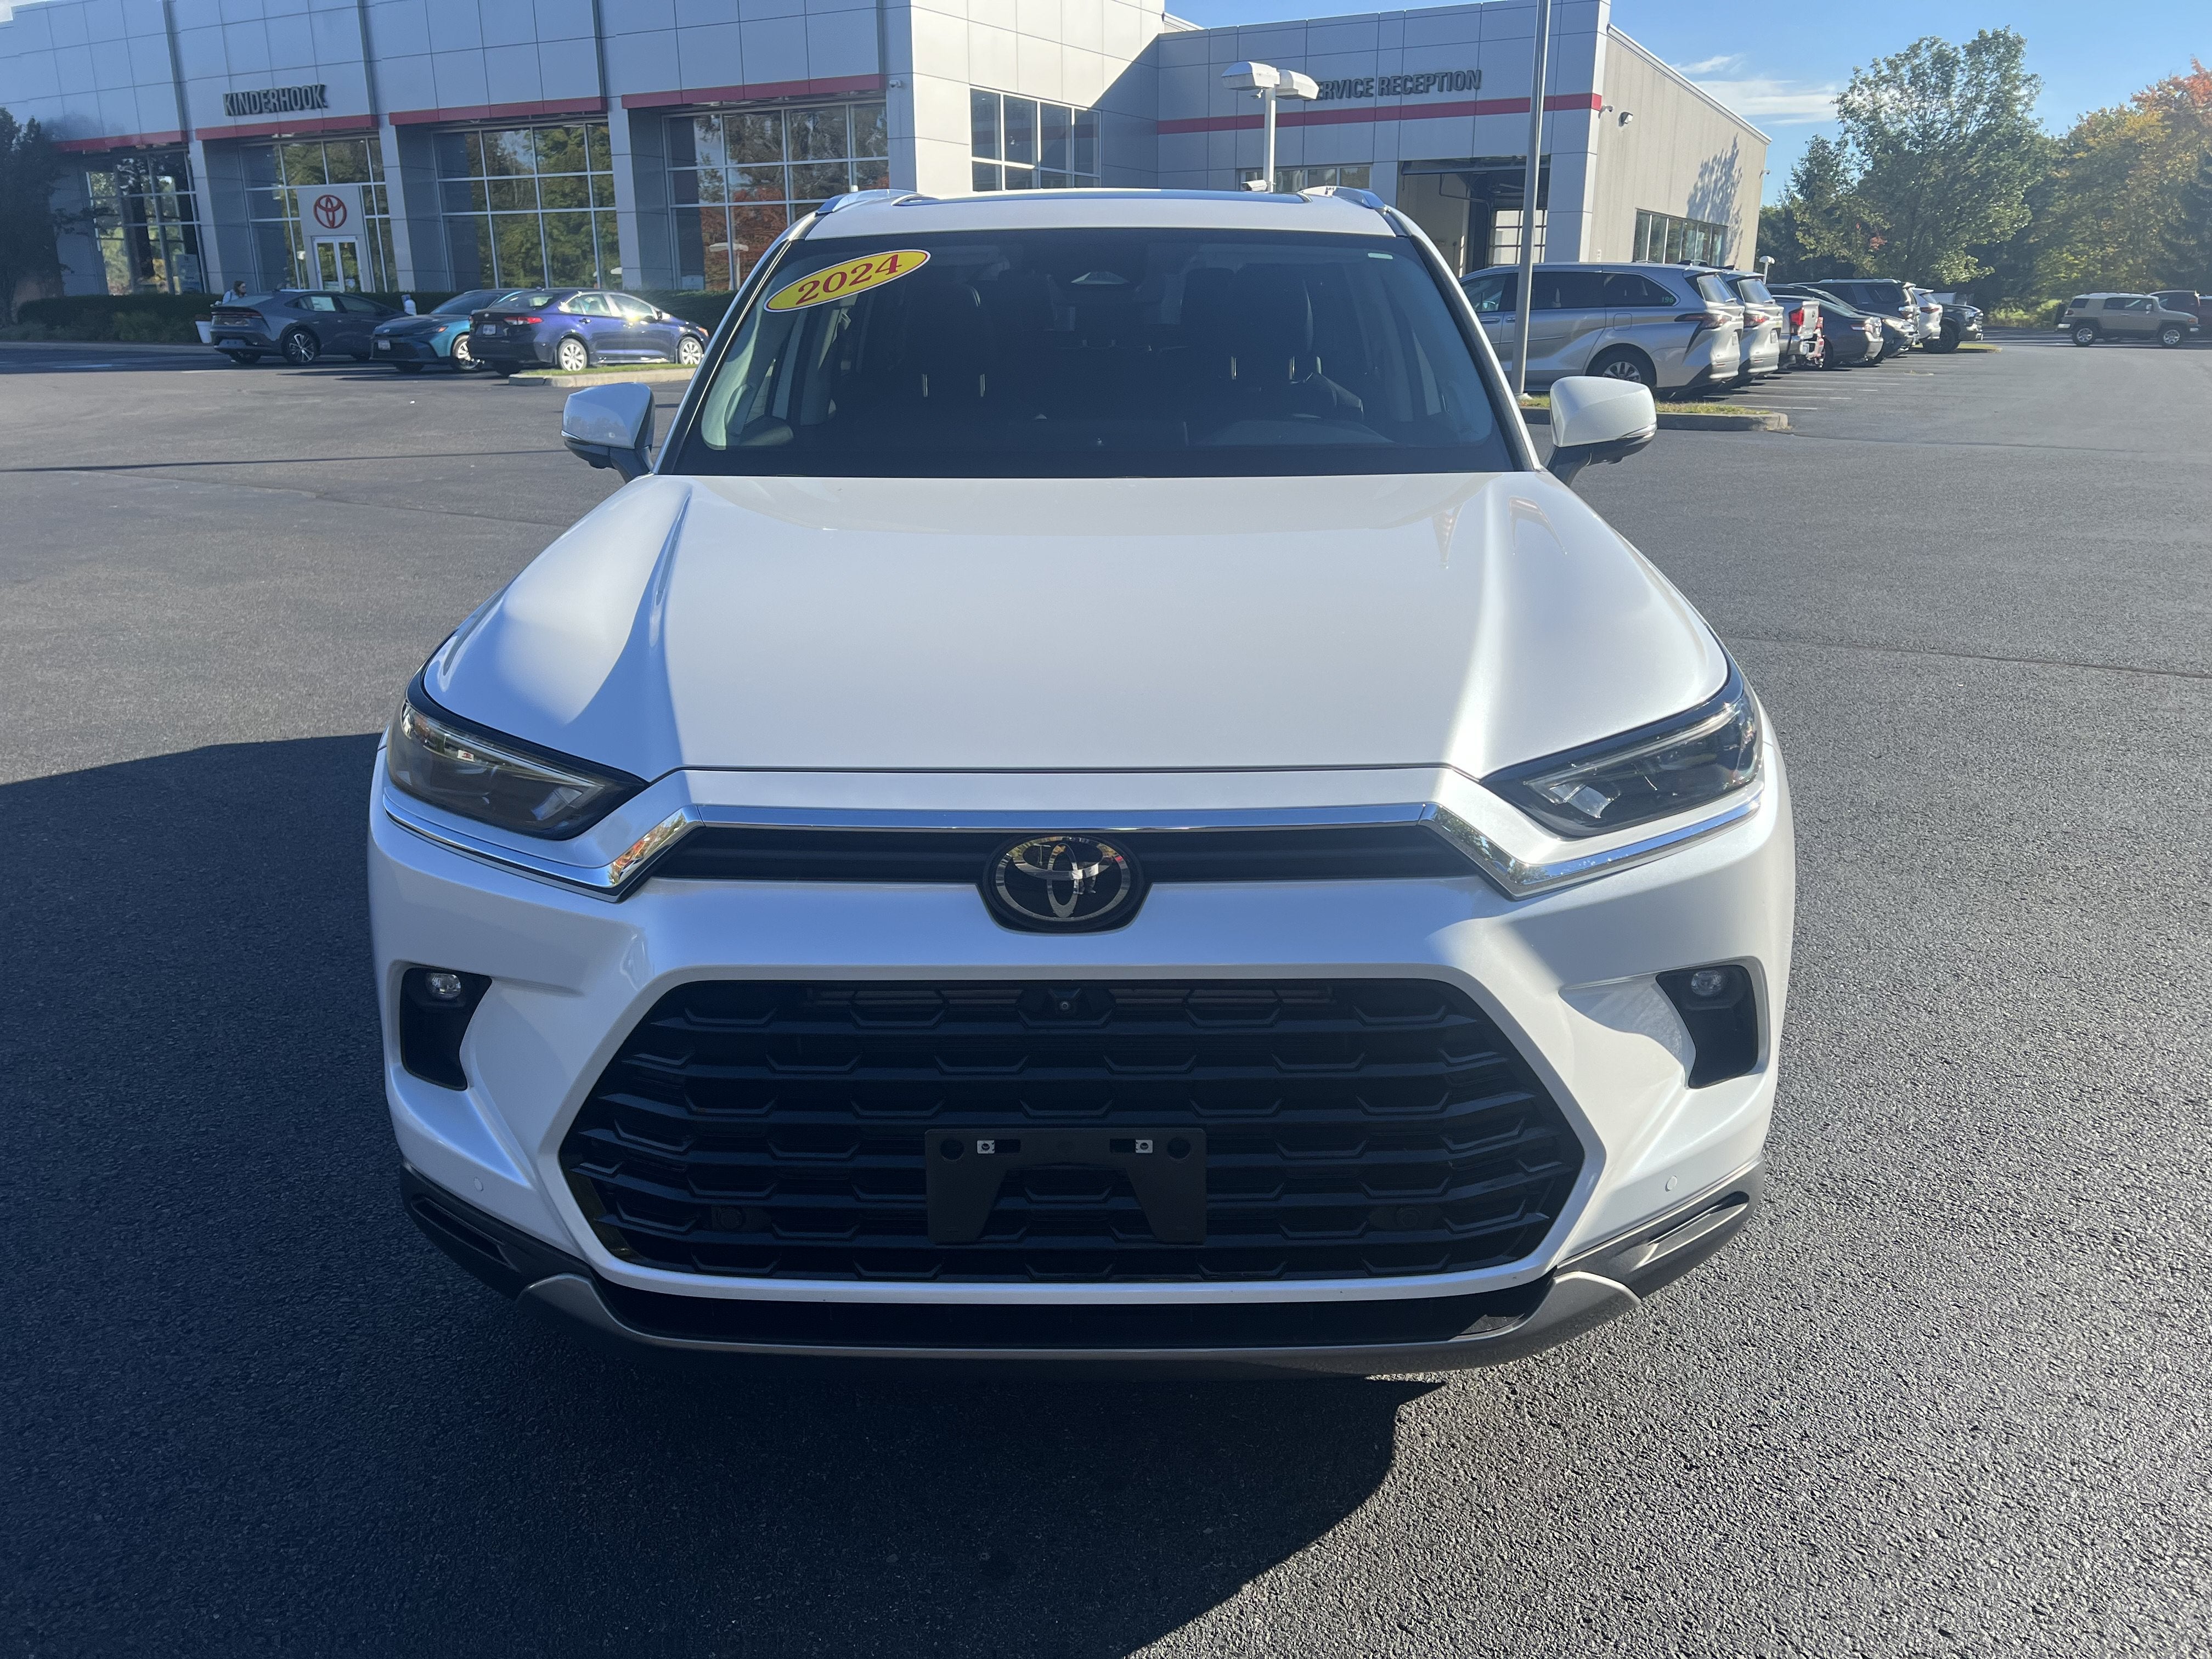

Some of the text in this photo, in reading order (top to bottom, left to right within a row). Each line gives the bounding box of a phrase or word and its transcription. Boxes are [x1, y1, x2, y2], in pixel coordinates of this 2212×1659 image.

[223, 84, 329, 116] KINDERHOOK
[1311, 70, 1481, 100] ERVICE RECEPTION
[795, 255, 902, 305] 2024
